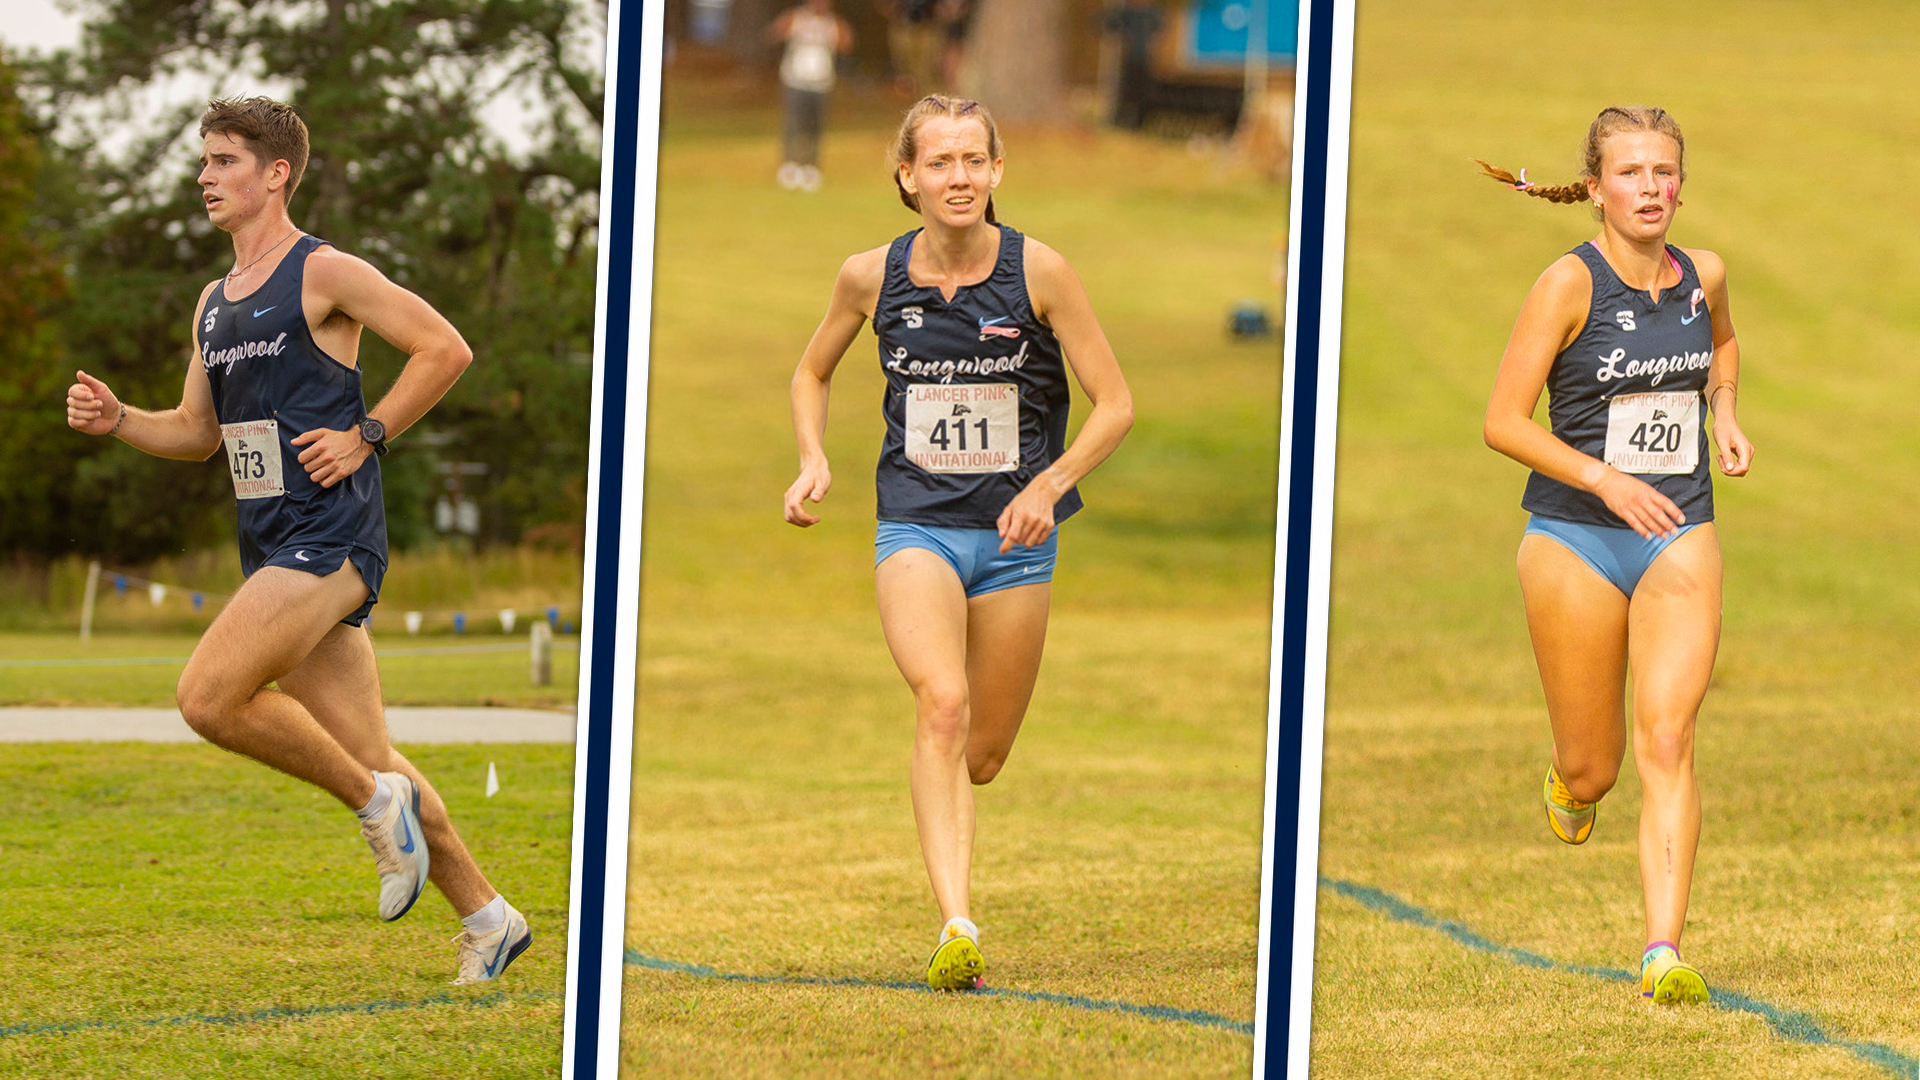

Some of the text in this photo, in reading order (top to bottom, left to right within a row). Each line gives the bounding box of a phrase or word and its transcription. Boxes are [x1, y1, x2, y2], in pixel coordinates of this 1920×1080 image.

[201, 332, 287, 376] Longwood
[886, 341, 1029, 384] Longwood
[915, 386, 1007, 402] LANCER PINK
[223, 422, 270, 439] ANCER PINK
[930, 418, 988, 451] 411
[1628, 423, 1682, 453] 420
[233, 450, 266, 480] 473
[915, 451, 1009, 468] INVITATIONAL
[1613, 453, 1690, 468] INVITATIONAL
